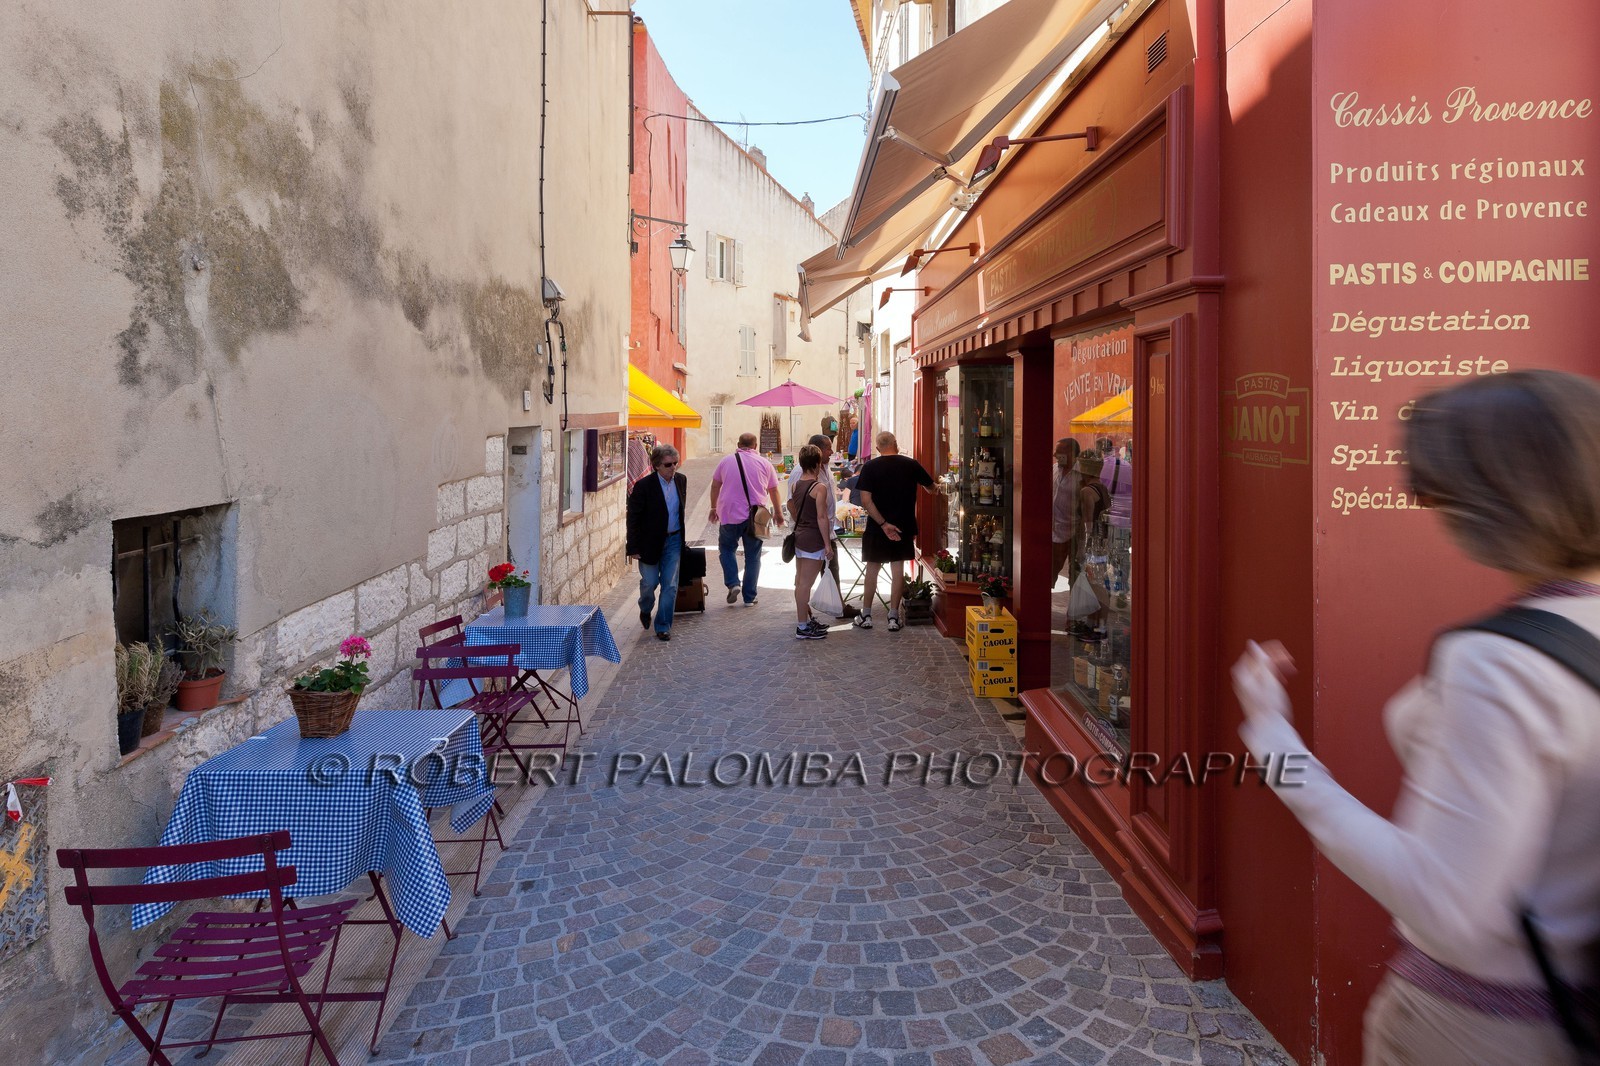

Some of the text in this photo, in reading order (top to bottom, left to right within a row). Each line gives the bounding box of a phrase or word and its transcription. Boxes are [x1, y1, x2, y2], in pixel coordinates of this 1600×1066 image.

[1330, 86, 1593, 128] Cassis Provence
[1330, 157, 1585, 184] Produits régionaux
[1330, 199, 1588, 223] Cadeaux de Provence
[1329, 258, 1590, 285] PASTIS & COMPAGNIE
[1330, 309, 1531, 338] Dégustation
[1072, 338, 1127, 365] Dégustation
[1330, 354, 1509, 382] Liquoriste
[1063, 371, 1091, 406] VENTE
[1093, 376, 1104, 392] EN
[1150, 376, 1156, 396] 9
[1243, 377, 1280, 391] PASTIS
[1330, 400, 1379, 421] Vin
[1228, 405, 1300, 444] JANOT
[1245, 452, 1280, 465] AUBAGNE
[983, 637, 1014, 648] CAGOLE
[983, 676, 1014, 686] CAGOLE
